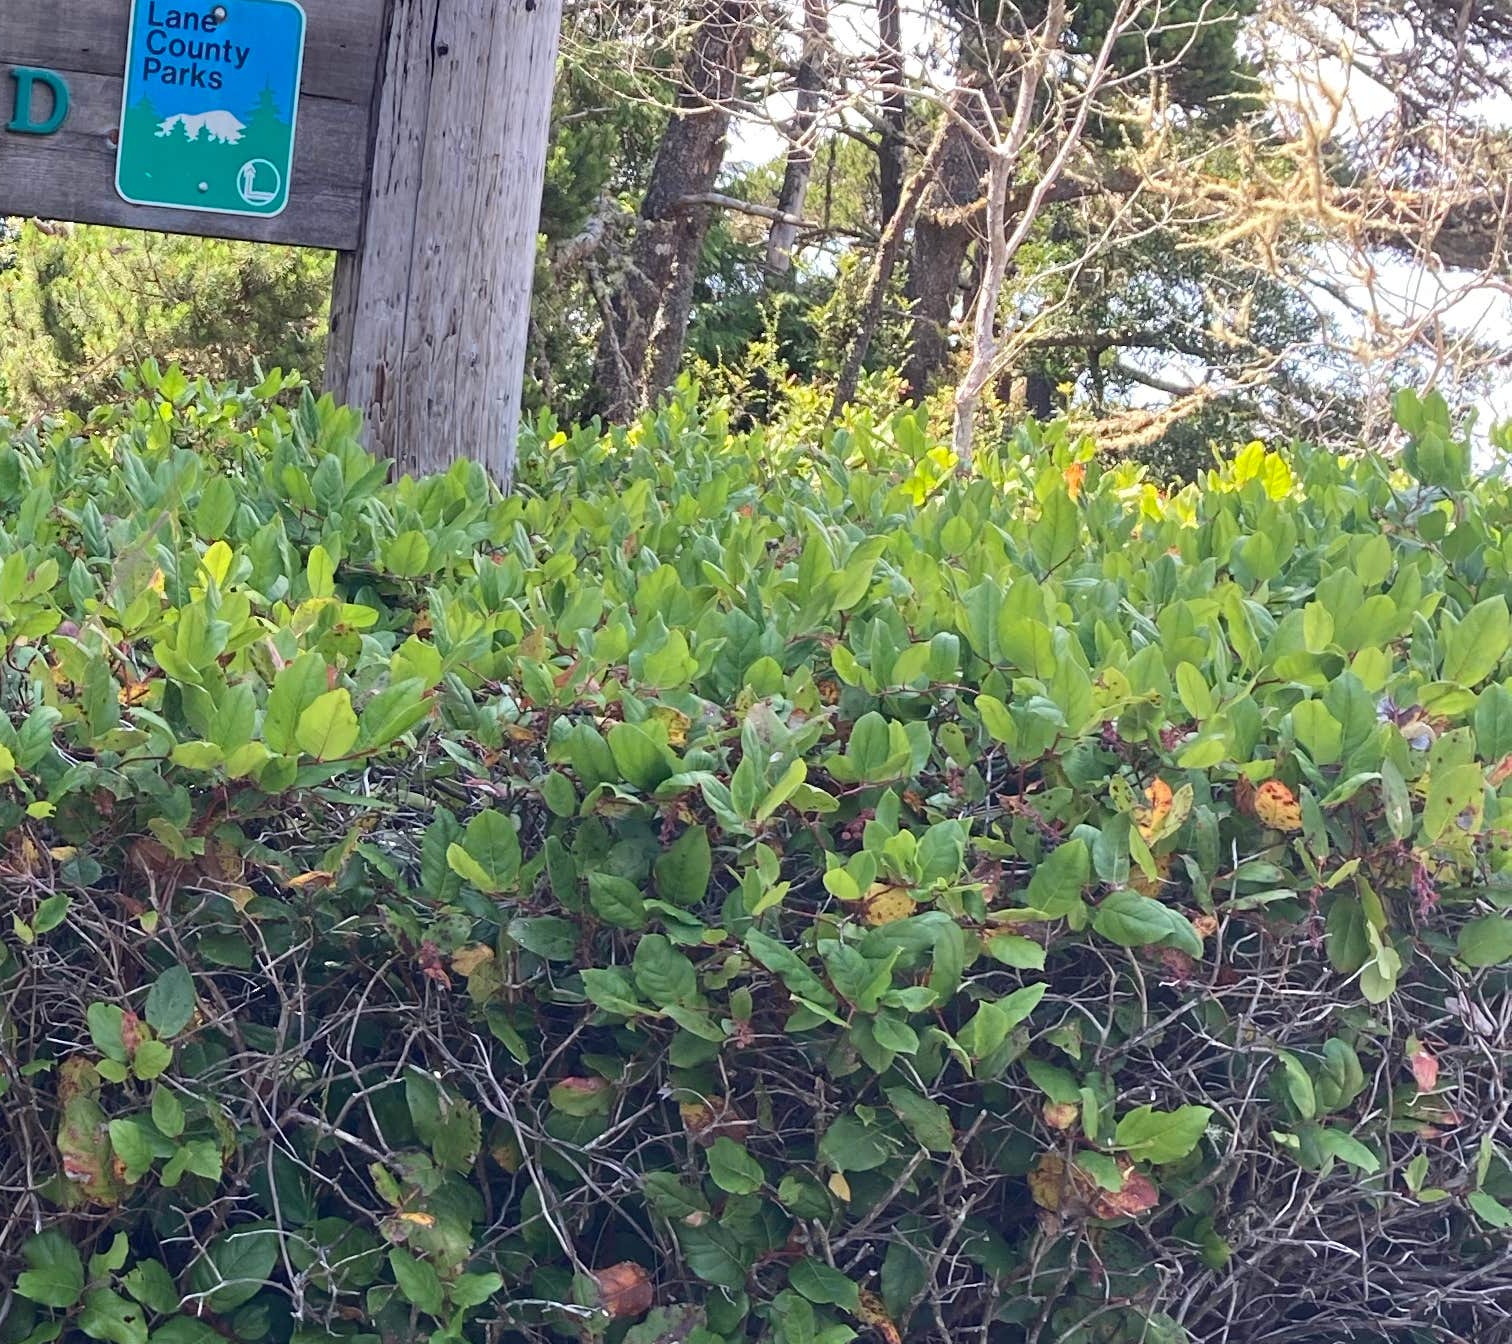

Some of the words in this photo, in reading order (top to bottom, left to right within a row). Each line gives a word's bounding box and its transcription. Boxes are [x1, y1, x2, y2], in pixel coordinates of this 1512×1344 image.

[148, 1, 218, 33] Lane
[146, 30, 250, 69] County
[143, 58, 223, 90] Parks
